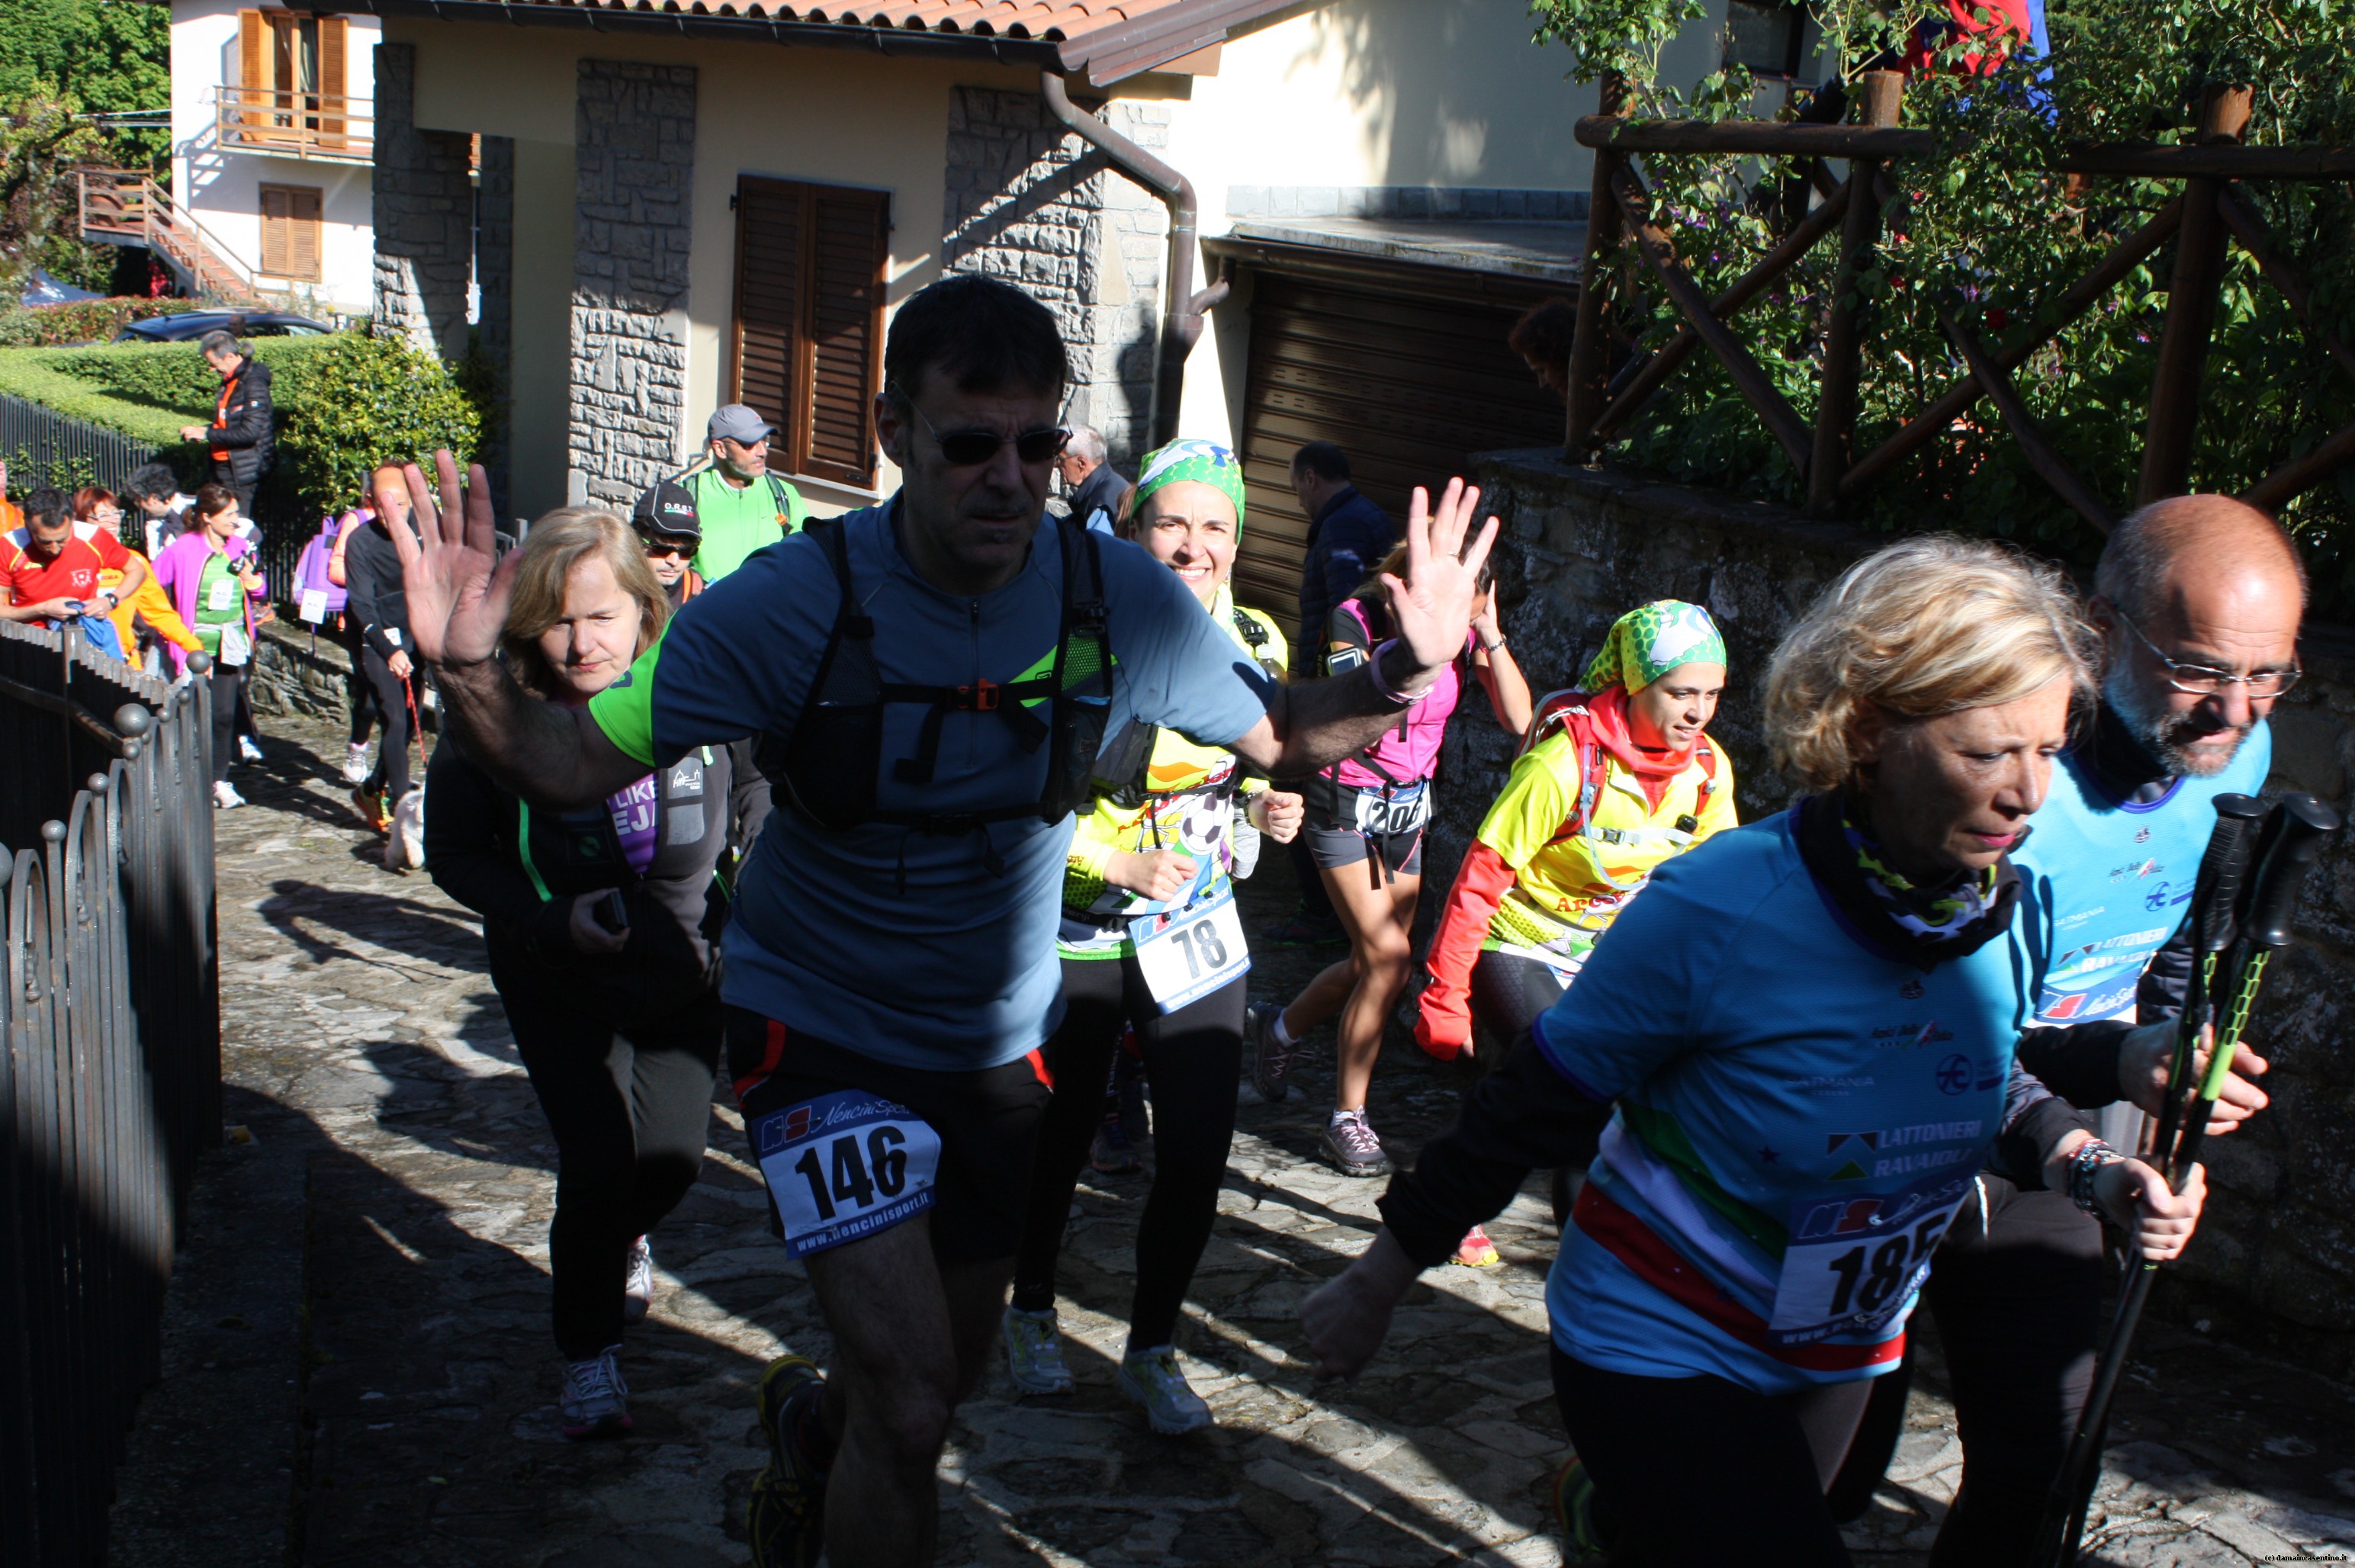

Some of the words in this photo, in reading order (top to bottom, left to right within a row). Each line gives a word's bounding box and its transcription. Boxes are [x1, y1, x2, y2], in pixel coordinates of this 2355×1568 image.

[1171, 919, 1228, 980] 78
[795, 1125, 908, 1221] 146
[796, 1191, 930, 1252] www.nencinisport.it
